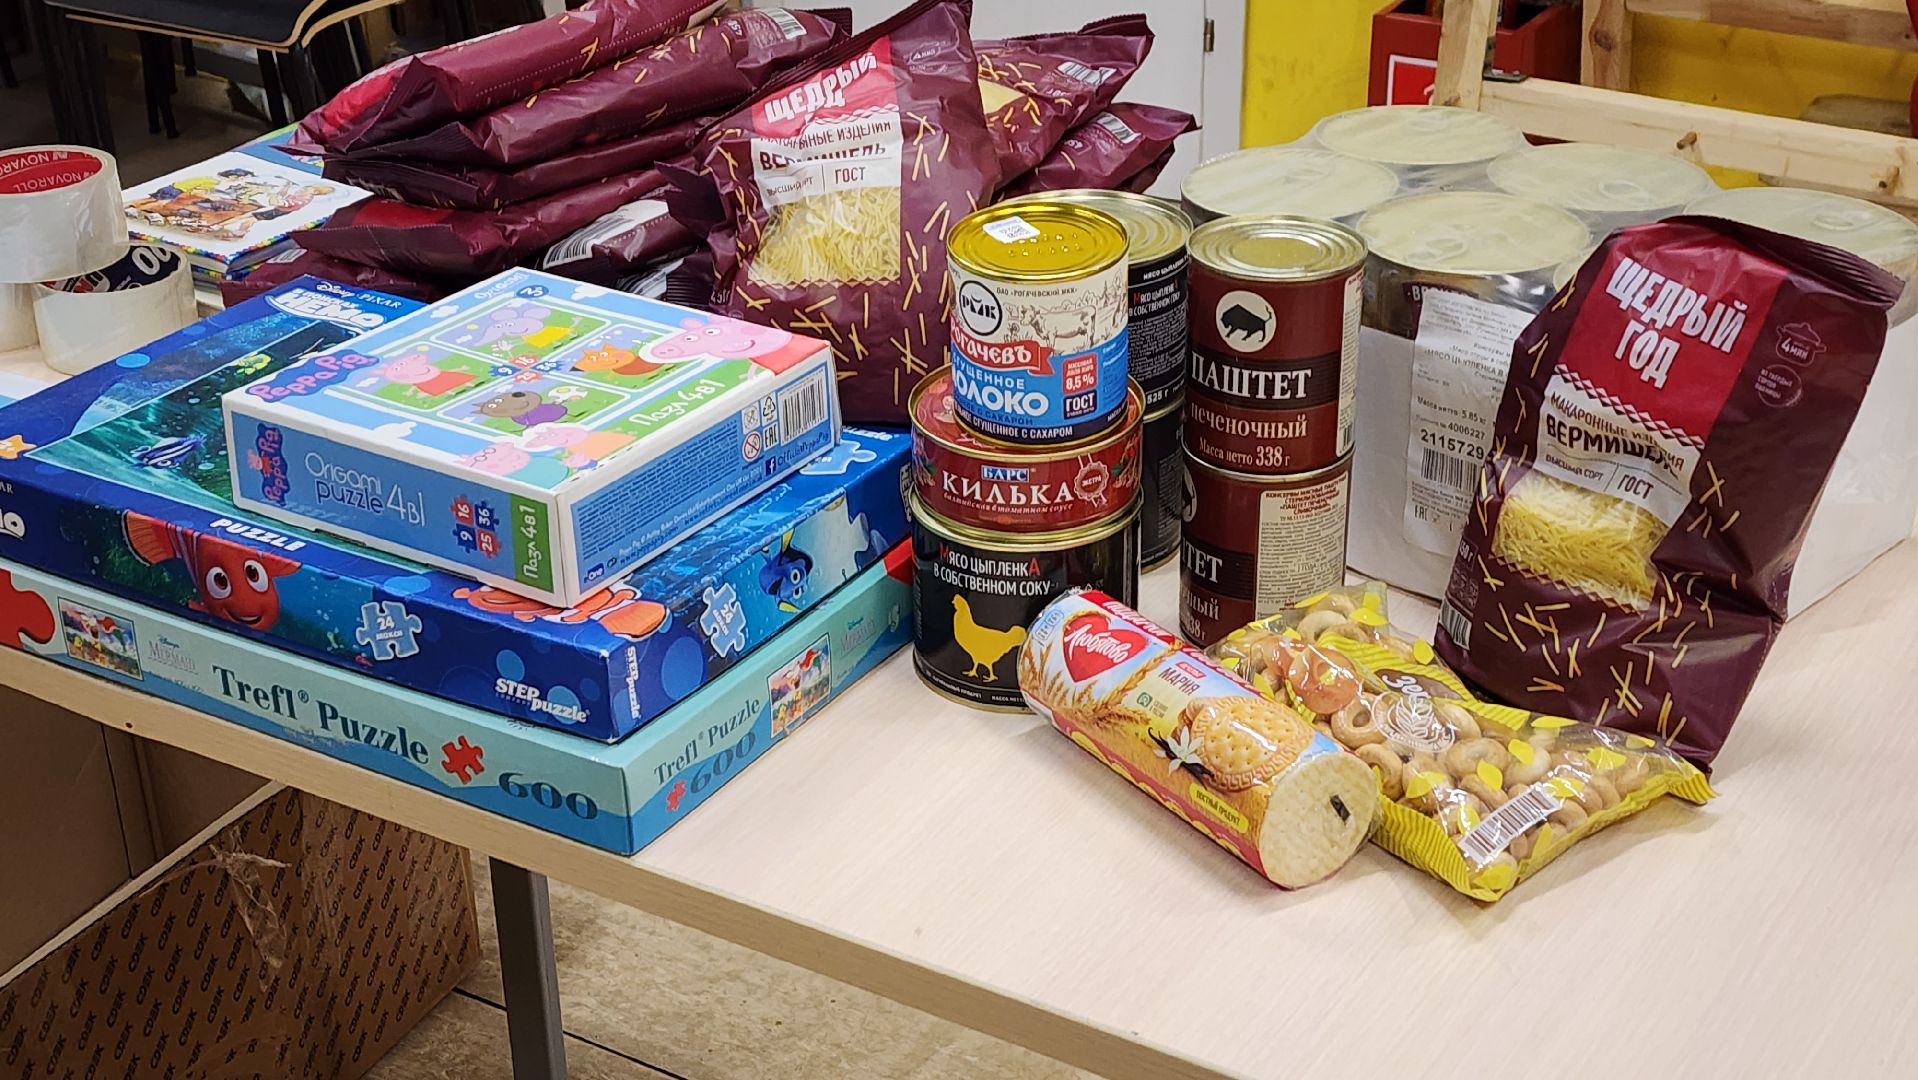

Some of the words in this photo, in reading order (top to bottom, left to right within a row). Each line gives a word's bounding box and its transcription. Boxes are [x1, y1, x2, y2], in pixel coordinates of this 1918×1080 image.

[764, 52, 877, 124] ЩЕДРЫЙ
[13, 171, 83, 193] NOVAROLL
[835, 167, 866, 185] ГОСТ
[359, 293, 401, 309] PIXAR
[1606, 256, 1749, 356] ЩЕДРЫЙ
[1614, 323, 1681, 389] ГОД
[249, 371, 339, 399] Peppa
[315, 353, 378, 371] Pig
[1192, 350, 1312, 400] ПАШТЕТ
[1066, 393, 1095, 412] ГОСТ
[1147, 391, 1163, 405] 525
[1550, 391, 1628, 438] МАКАРОННЫЕ
[1021, 429, 1028, 439] С
[1030, 426, 1073, 439] САХАРОМ
[1191, 401, 1308, 439] печеночный
[1199, 436, 1224, 460] Масса
[1226, 449, 1253, 466] нетто
[1255, 445, 1283, 467] 338
[1420, 428, 1485, 460] 2115729
[942, 470, 1075, 505] КИЛЬКА
[982, 465, 1028, 481] БАРС
[1584, 468, 1604, 481] СОРТ
[1617, 474, 1655, 499] ГОСТ
[316, 480, 385, 514] puzzle
[458, 503, 470, 518] 16
[998, 504, 1048, 514] томатном
[1049, 502, 1074, 512] соусе
[479, 507, 491, 526] 36
[209, 518, 306, 552] PUZZLE
[480, 533, 493, 552] 25
[523, 541, 541, 579] Пазл
[939, 544, 969, 571] МЯСО
[970, 557, 1041, 578] ЦЫПЛЕНКА
[934, 564, 940, 577] В
[940, 567, 1018, 595] СОБСТВЕННОМ
[1019, 579, 1050, 596] СОКУ
[376, 616, 395, 631] 24
[719, 605, 734, 624] 24
[1063, 624, 1129, 664] Любятово
[627, 645, 639, 681] STEP
[495, 677, 540, 700] STEP
[530, 698, 587, 723] puzzle
[708, 697, 761, 748] Puzzle
[317, 699, 430, 765] Puzzle
[690, 730, 756, 794] 600
[497, 771, 598, 821] 600
[349, 835, 366, 870] CDEK
[377, 846, 393, 880] CDEK
[353, 865, 370, 900] CDEK
[380, 874, 396, 909] CDEK
[358, 893, 374, 929] CDEK
[385, 905, 400, 938] CDEK
[158, 910, 177, 950] CDEK
[194, 922, 212, 960] CDEK
[128, 932, 148, 972] CDEK
[164, 942, 183, 983] CDEK
[227, 932, 245, 971] CDEK
[388, 931, 404, 967] CDEK
[100, 955, 118, 995] CDEK
[136, 965, 155, 1005] CDEK
[201, 952, 219, 992] CDEK
[233, 963, 250, 1002] CDEK
[107, 987, 126, 1028] CDEK
[172, 976, 190, 1015] CDEK
[207, 984, 225, 1024] CDEK
[144, 998, 163, 1037] CDEK
[179, 1007, 198, 1046] CDEK
[114, 1020, 133, 1060] CDEK
